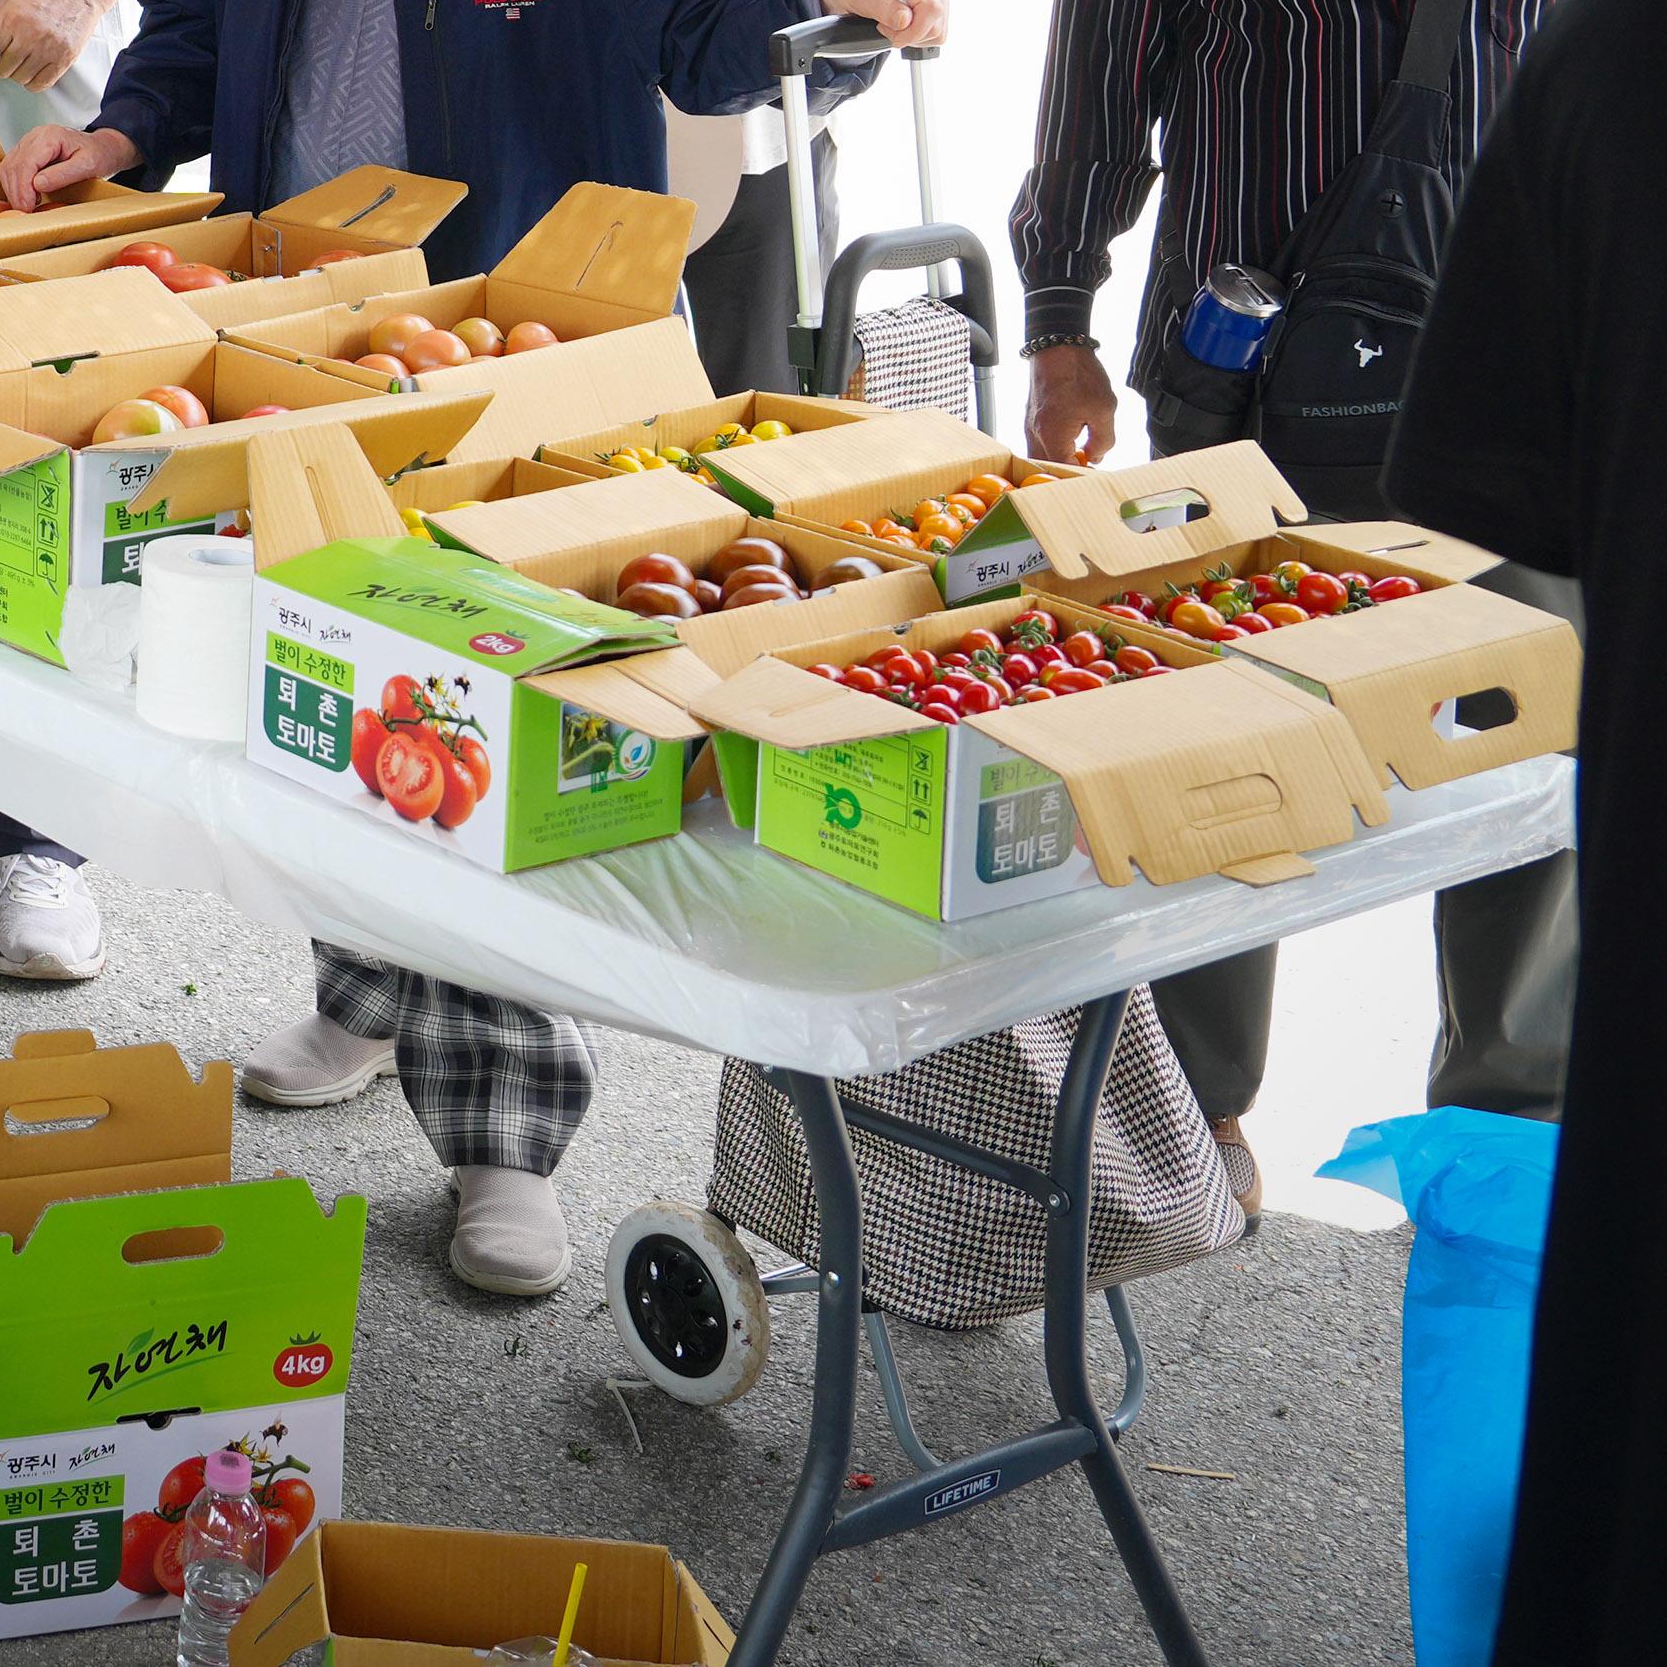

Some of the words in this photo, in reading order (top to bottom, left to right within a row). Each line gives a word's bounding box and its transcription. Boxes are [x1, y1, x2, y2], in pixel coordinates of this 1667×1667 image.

[976, 561, 1010, 582] 광주시
[350, 582, 497, 620] 자연채
[278, 607, 311, 633] 광주시
[320, 625, 351, 641] 자연채
[276, 640, 301, 669] 벌이
[306, 654, 348, 686] 수정한
[482, 636, 525, 655] 2kg
[276, 715, 336, 762] 토마토
[991, 831, 1059, 875] 토마토
[87, 1320, 228, 1401] 자연채
[281, 1352, 325, 1379] 4kg
[8, 1454, 56, 1475] 광주시
[69, 1444, 114, 1469] 자연채
[5, 1490, 43, 1516] 벌이
[51, 1481, 111, 1509] 수정한
[933, 1476, 992, 1509] LIFETIME
[11, 1559, 99, 1596] 토마토
